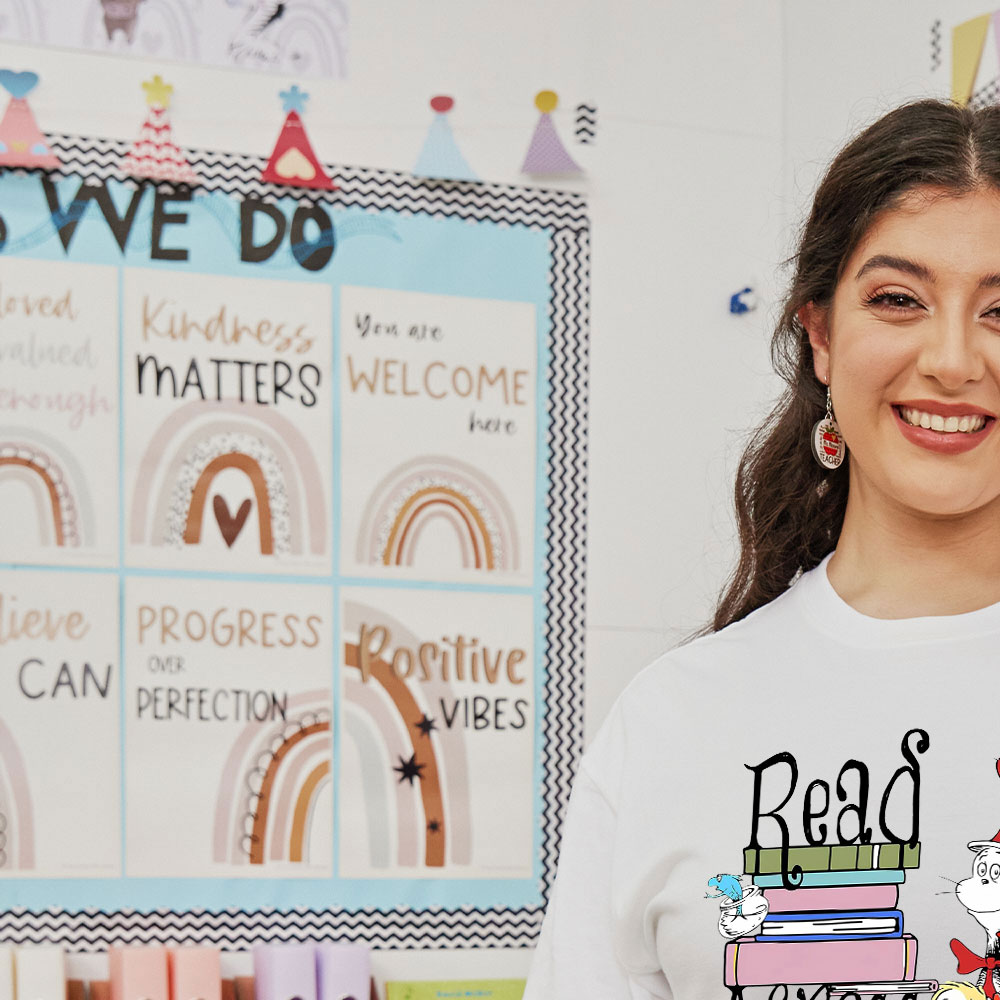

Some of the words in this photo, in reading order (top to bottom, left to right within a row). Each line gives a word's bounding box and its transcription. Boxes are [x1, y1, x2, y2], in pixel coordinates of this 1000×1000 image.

[40, 173, 194, 261] WE
[240, 194, 336, 272] DO
[0, 282, 79, 321] oved
[142, 294, 316, 354] Kindness
[354, 312, 400, 338] You
[407, 323, 443, 341] are
[0, 331, 98, 370] alued
[135, 353, 322, 408] MATTERS
[346, 354, 529, 406] WELCOME
[468, 410, 517, 434] here
[136, 605, 323, 649] PROGRESS
[149, 654, 186, 675] OVER
[359, 623, 527, 685] Positive
[18, 658, 113, 700] CAN
[136, 685, 290, 722] PERFECTION
[438, 696, 529, 731] VIBES
[744, 728, 930, 891] Read
